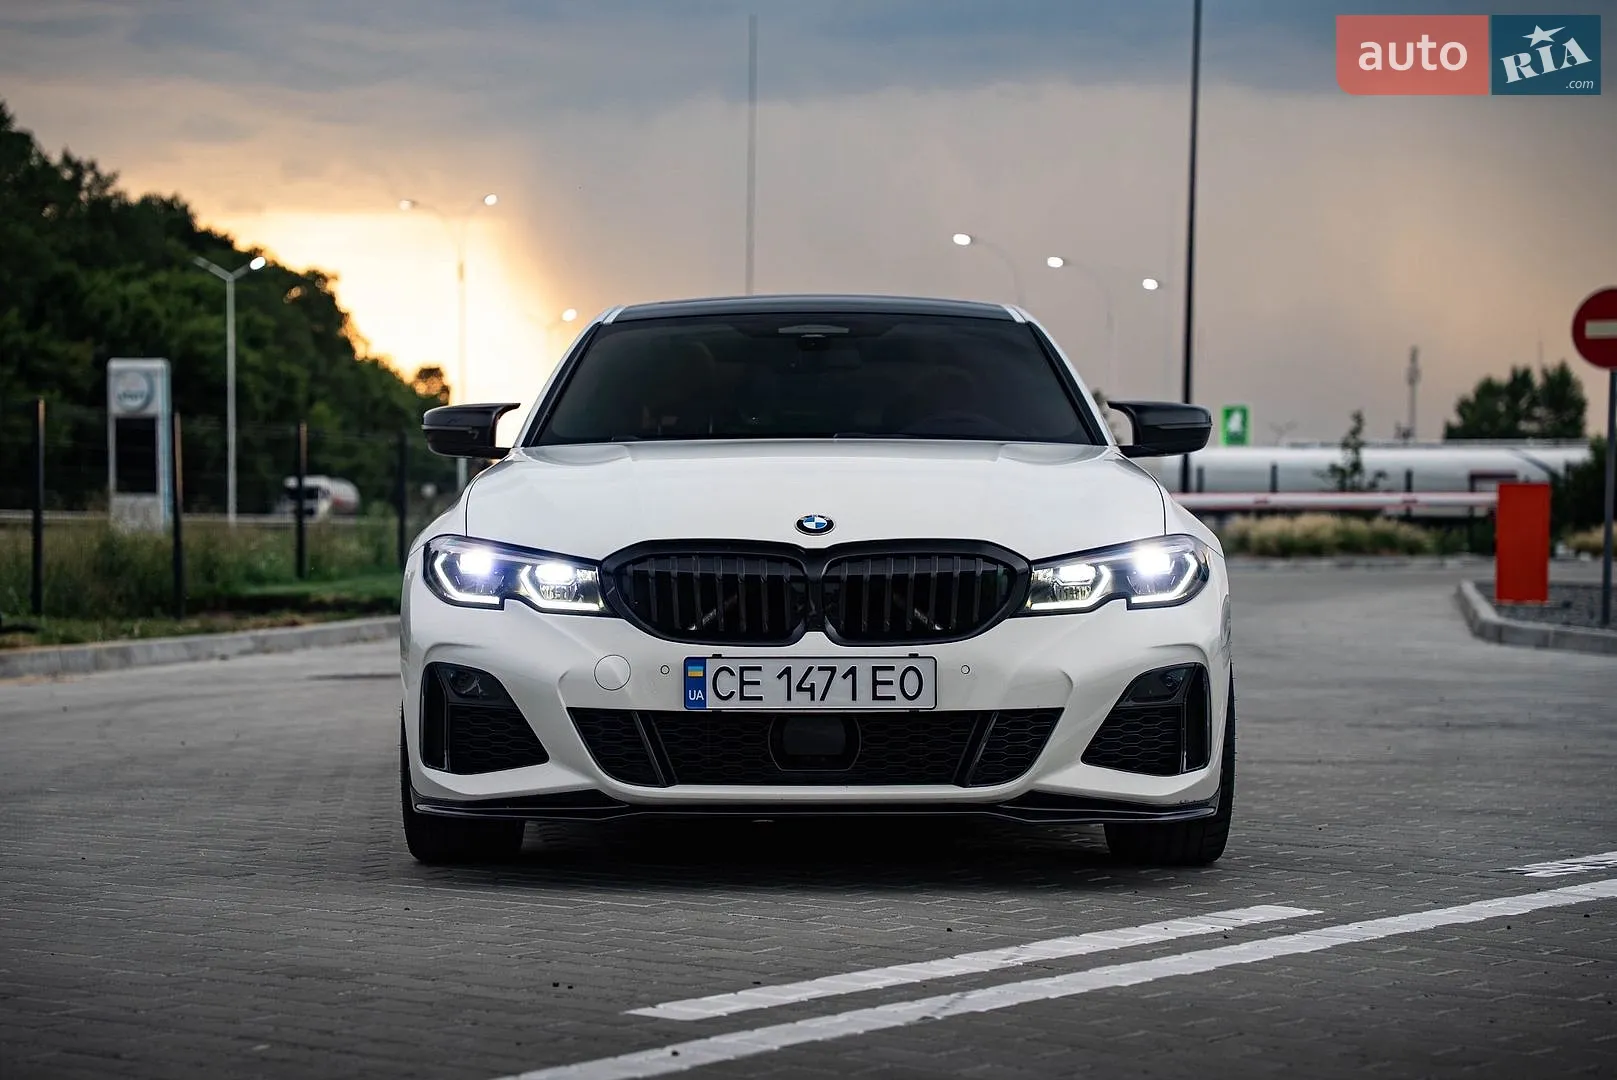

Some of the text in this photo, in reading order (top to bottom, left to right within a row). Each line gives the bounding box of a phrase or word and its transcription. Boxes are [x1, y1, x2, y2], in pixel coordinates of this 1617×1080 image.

[689, 689, 704, 700] UA
[712, 665, 924, 701] CE 1471 EO
